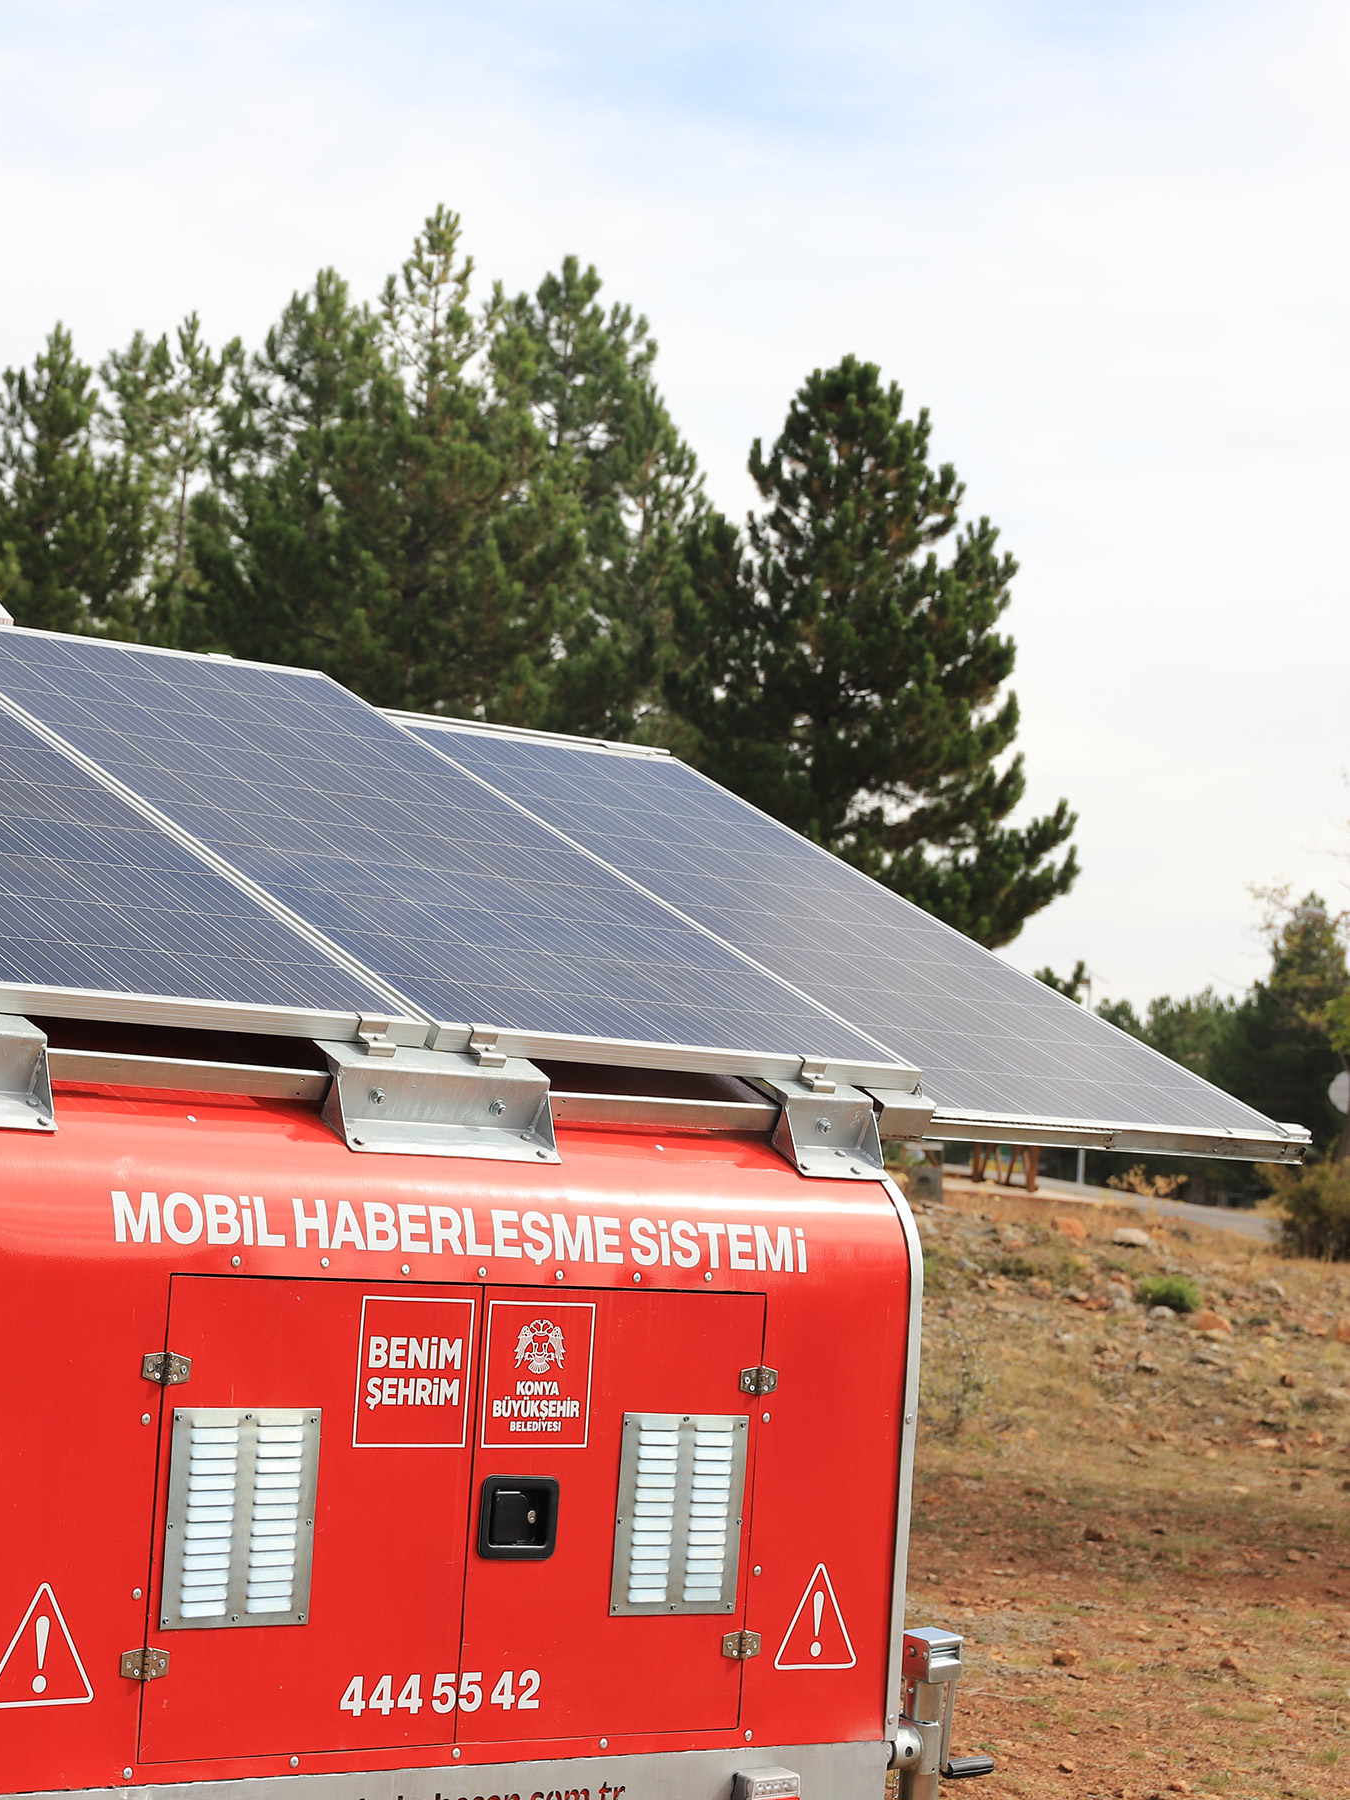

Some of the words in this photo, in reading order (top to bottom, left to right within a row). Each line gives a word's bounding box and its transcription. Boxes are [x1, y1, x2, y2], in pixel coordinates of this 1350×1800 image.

[292, 1198, 623, 1265] HABERLEŞME
[516, 1381, 560, 1396] KONYA
[492, 1396, 580, 1420] BÜYÜKŞEHİR
[340, 1675, 423, 1716] 444
[431, 1672, 483, 1713] 55
[491, 1670, 542, 1710] 42
